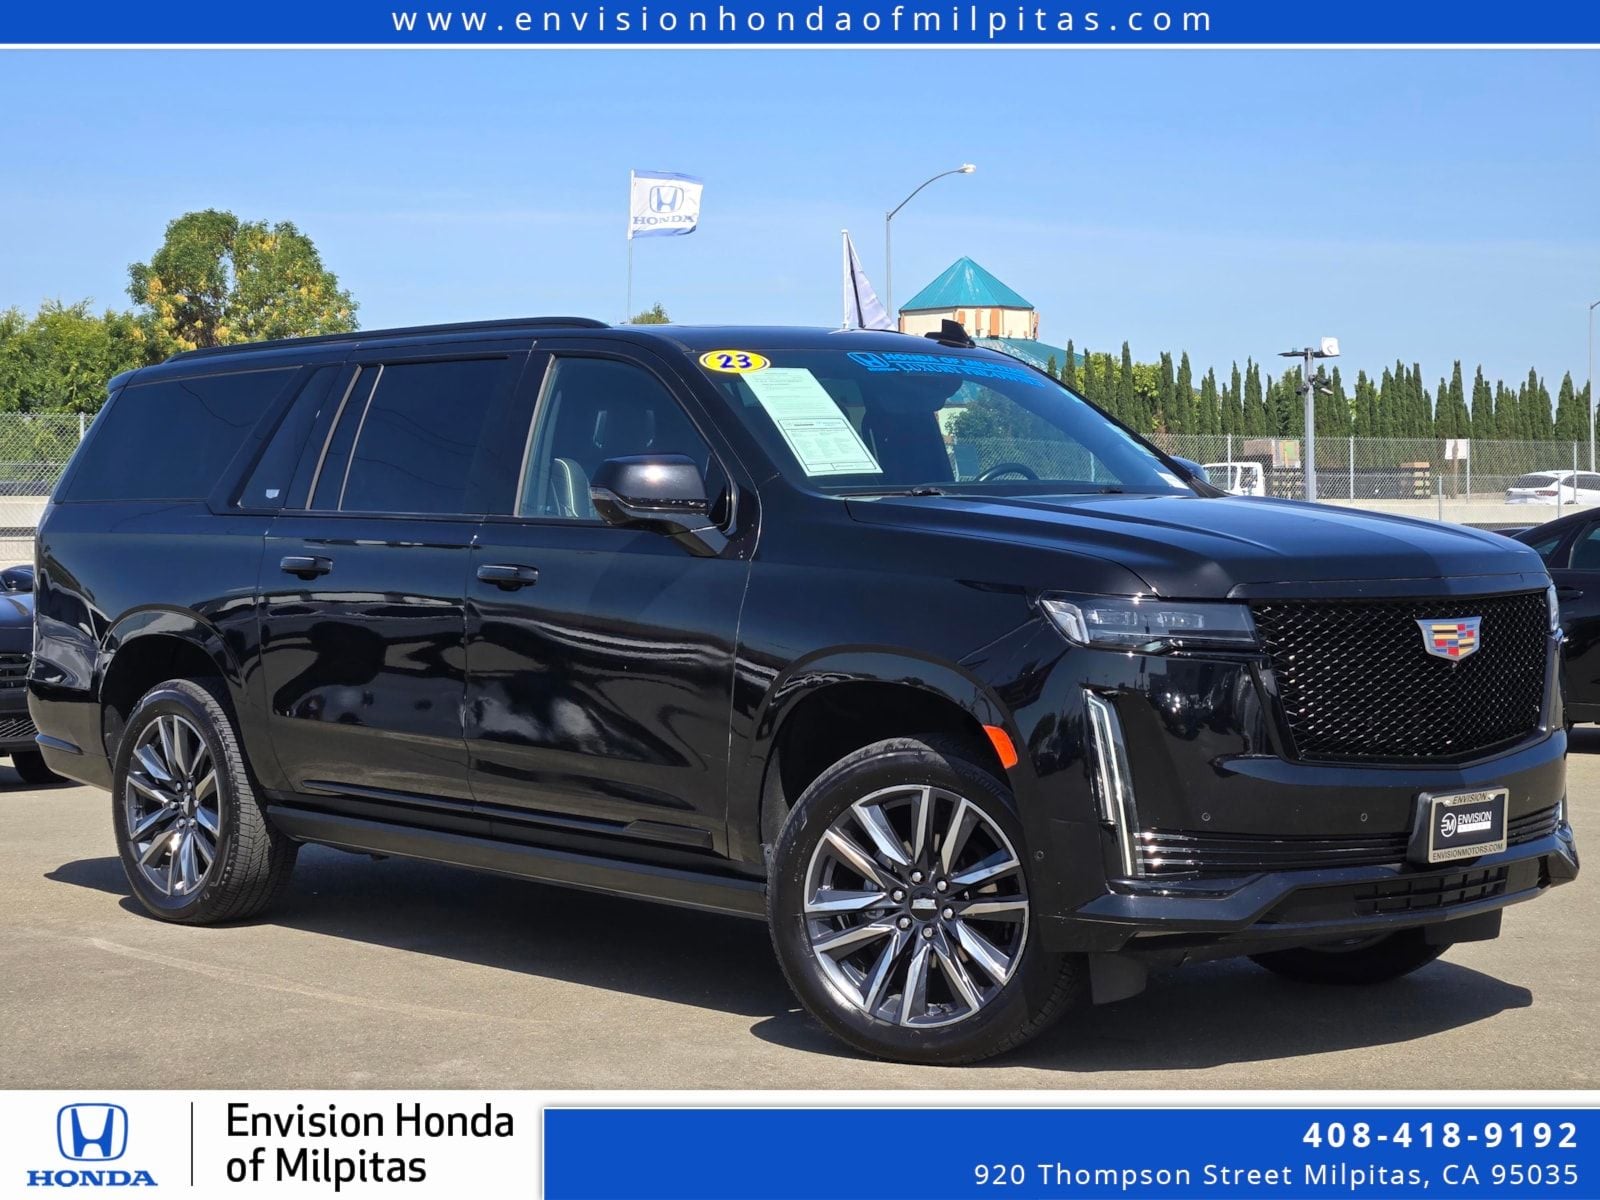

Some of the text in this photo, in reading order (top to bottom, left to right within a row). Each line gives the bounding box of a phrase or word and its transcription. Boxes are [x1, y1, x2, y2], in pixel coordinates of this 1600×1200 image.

[633, 215, 695, 225] HONDA
[717, 354, 752, 369] 23
[1453, 792, 1488, 804] ENVISION
[1457, 811, 1492, 825] ENVISION
[1432, 842, 1504, 861] ENVISIONMOTORS.COM
